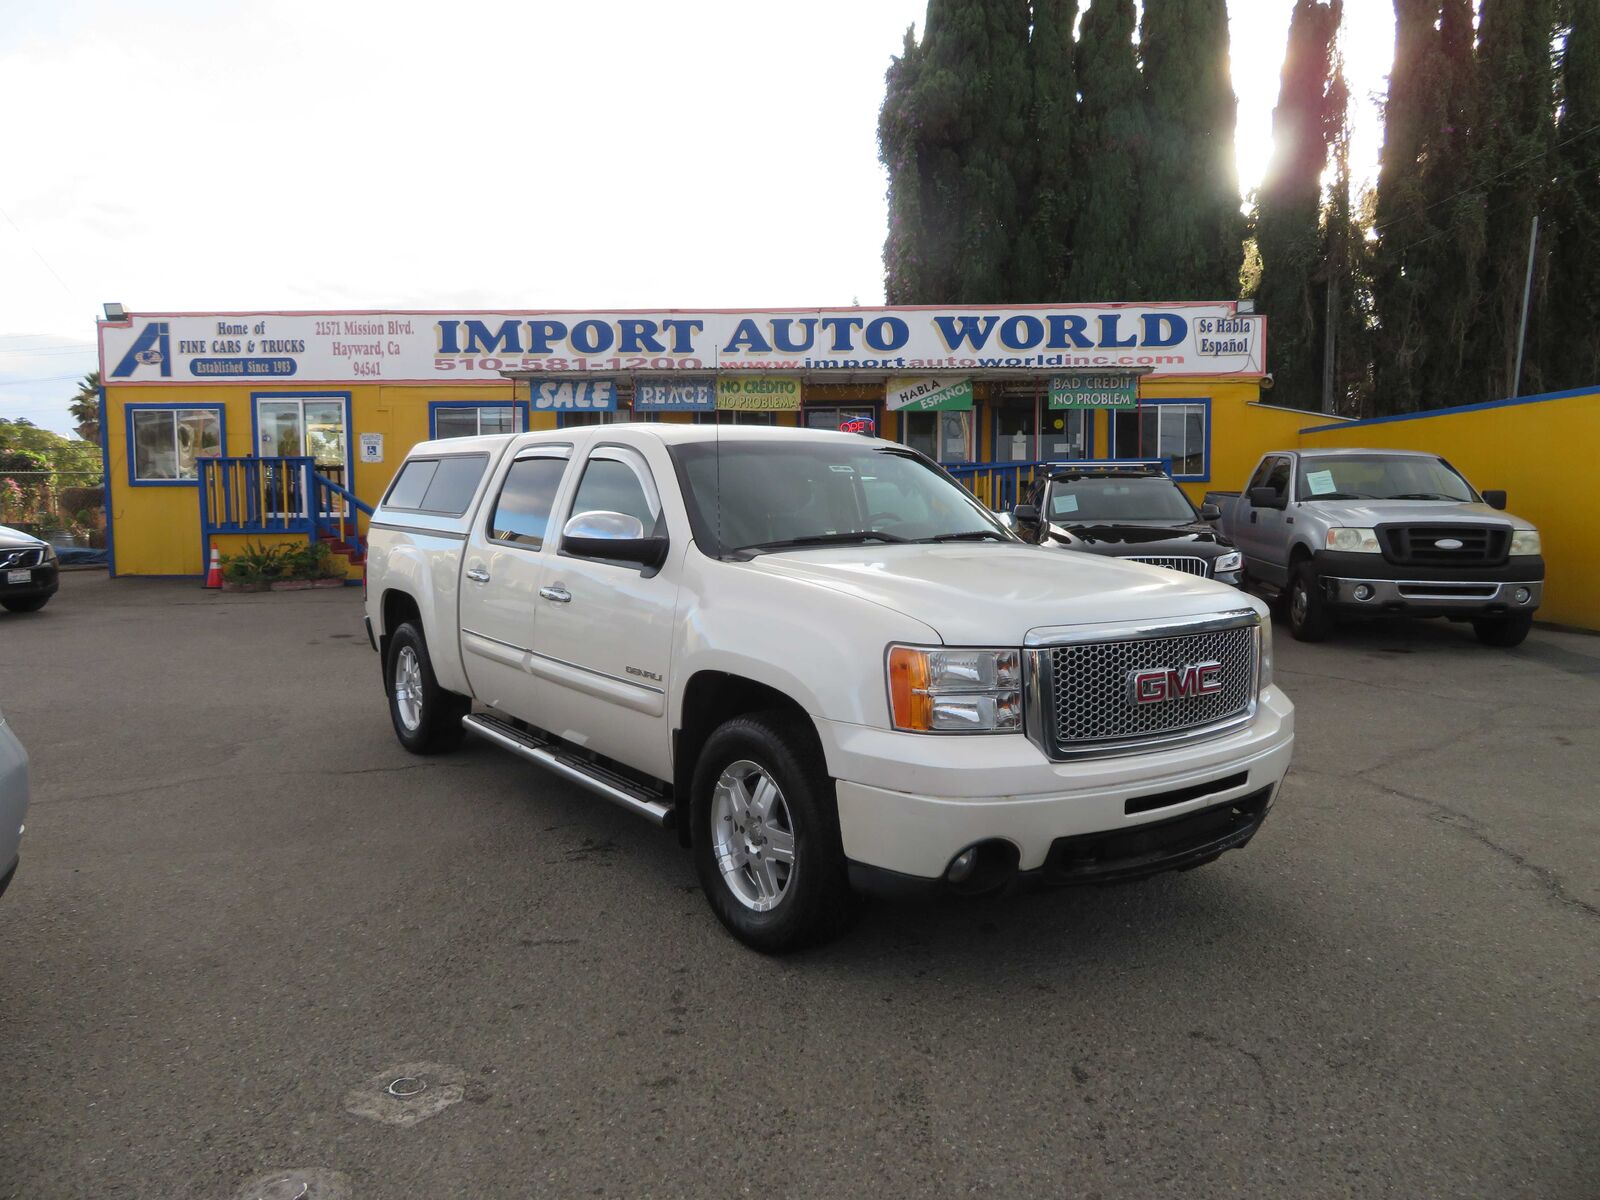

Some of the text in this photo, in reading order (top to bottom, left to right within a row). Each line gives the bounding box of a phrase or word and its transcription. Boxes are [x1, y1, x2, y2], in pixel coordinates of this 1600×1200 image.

[217, 320, 265, 335] Home of
[315, 320, 414, 335] 21571 Mission Blvd.
[1199, 318, 1250, 333] Se Habla
[436, 313, 1188, 354] IMPORT AUTO WORLD
[179, 339, 305, 353] FINE CARS & TRUCKS
[332, 341, 400, 359] Hayward, Ca
[1201, 337, 1248, 357] Español
[197, 360, 243, 373] Established
[247, 361, 269, 373] Since
[353, 361, 381, 376] 94541
[434, 357, 703, 371] 510-581-1200
[721, 381, 741, 394] NO
[1053, 377, 1131, 390] BAD CREDIT
[536, 381, 611, 408] SALE
[900, 380, 941, 403] HABLA
[1054, 393, 1131, 405] NO PROBLEM
[718, 396, 798, 409] NO PROBLEMA
[625, 665, 663, 681] DENALI
[1134, 661, 1222, 704] GMC
